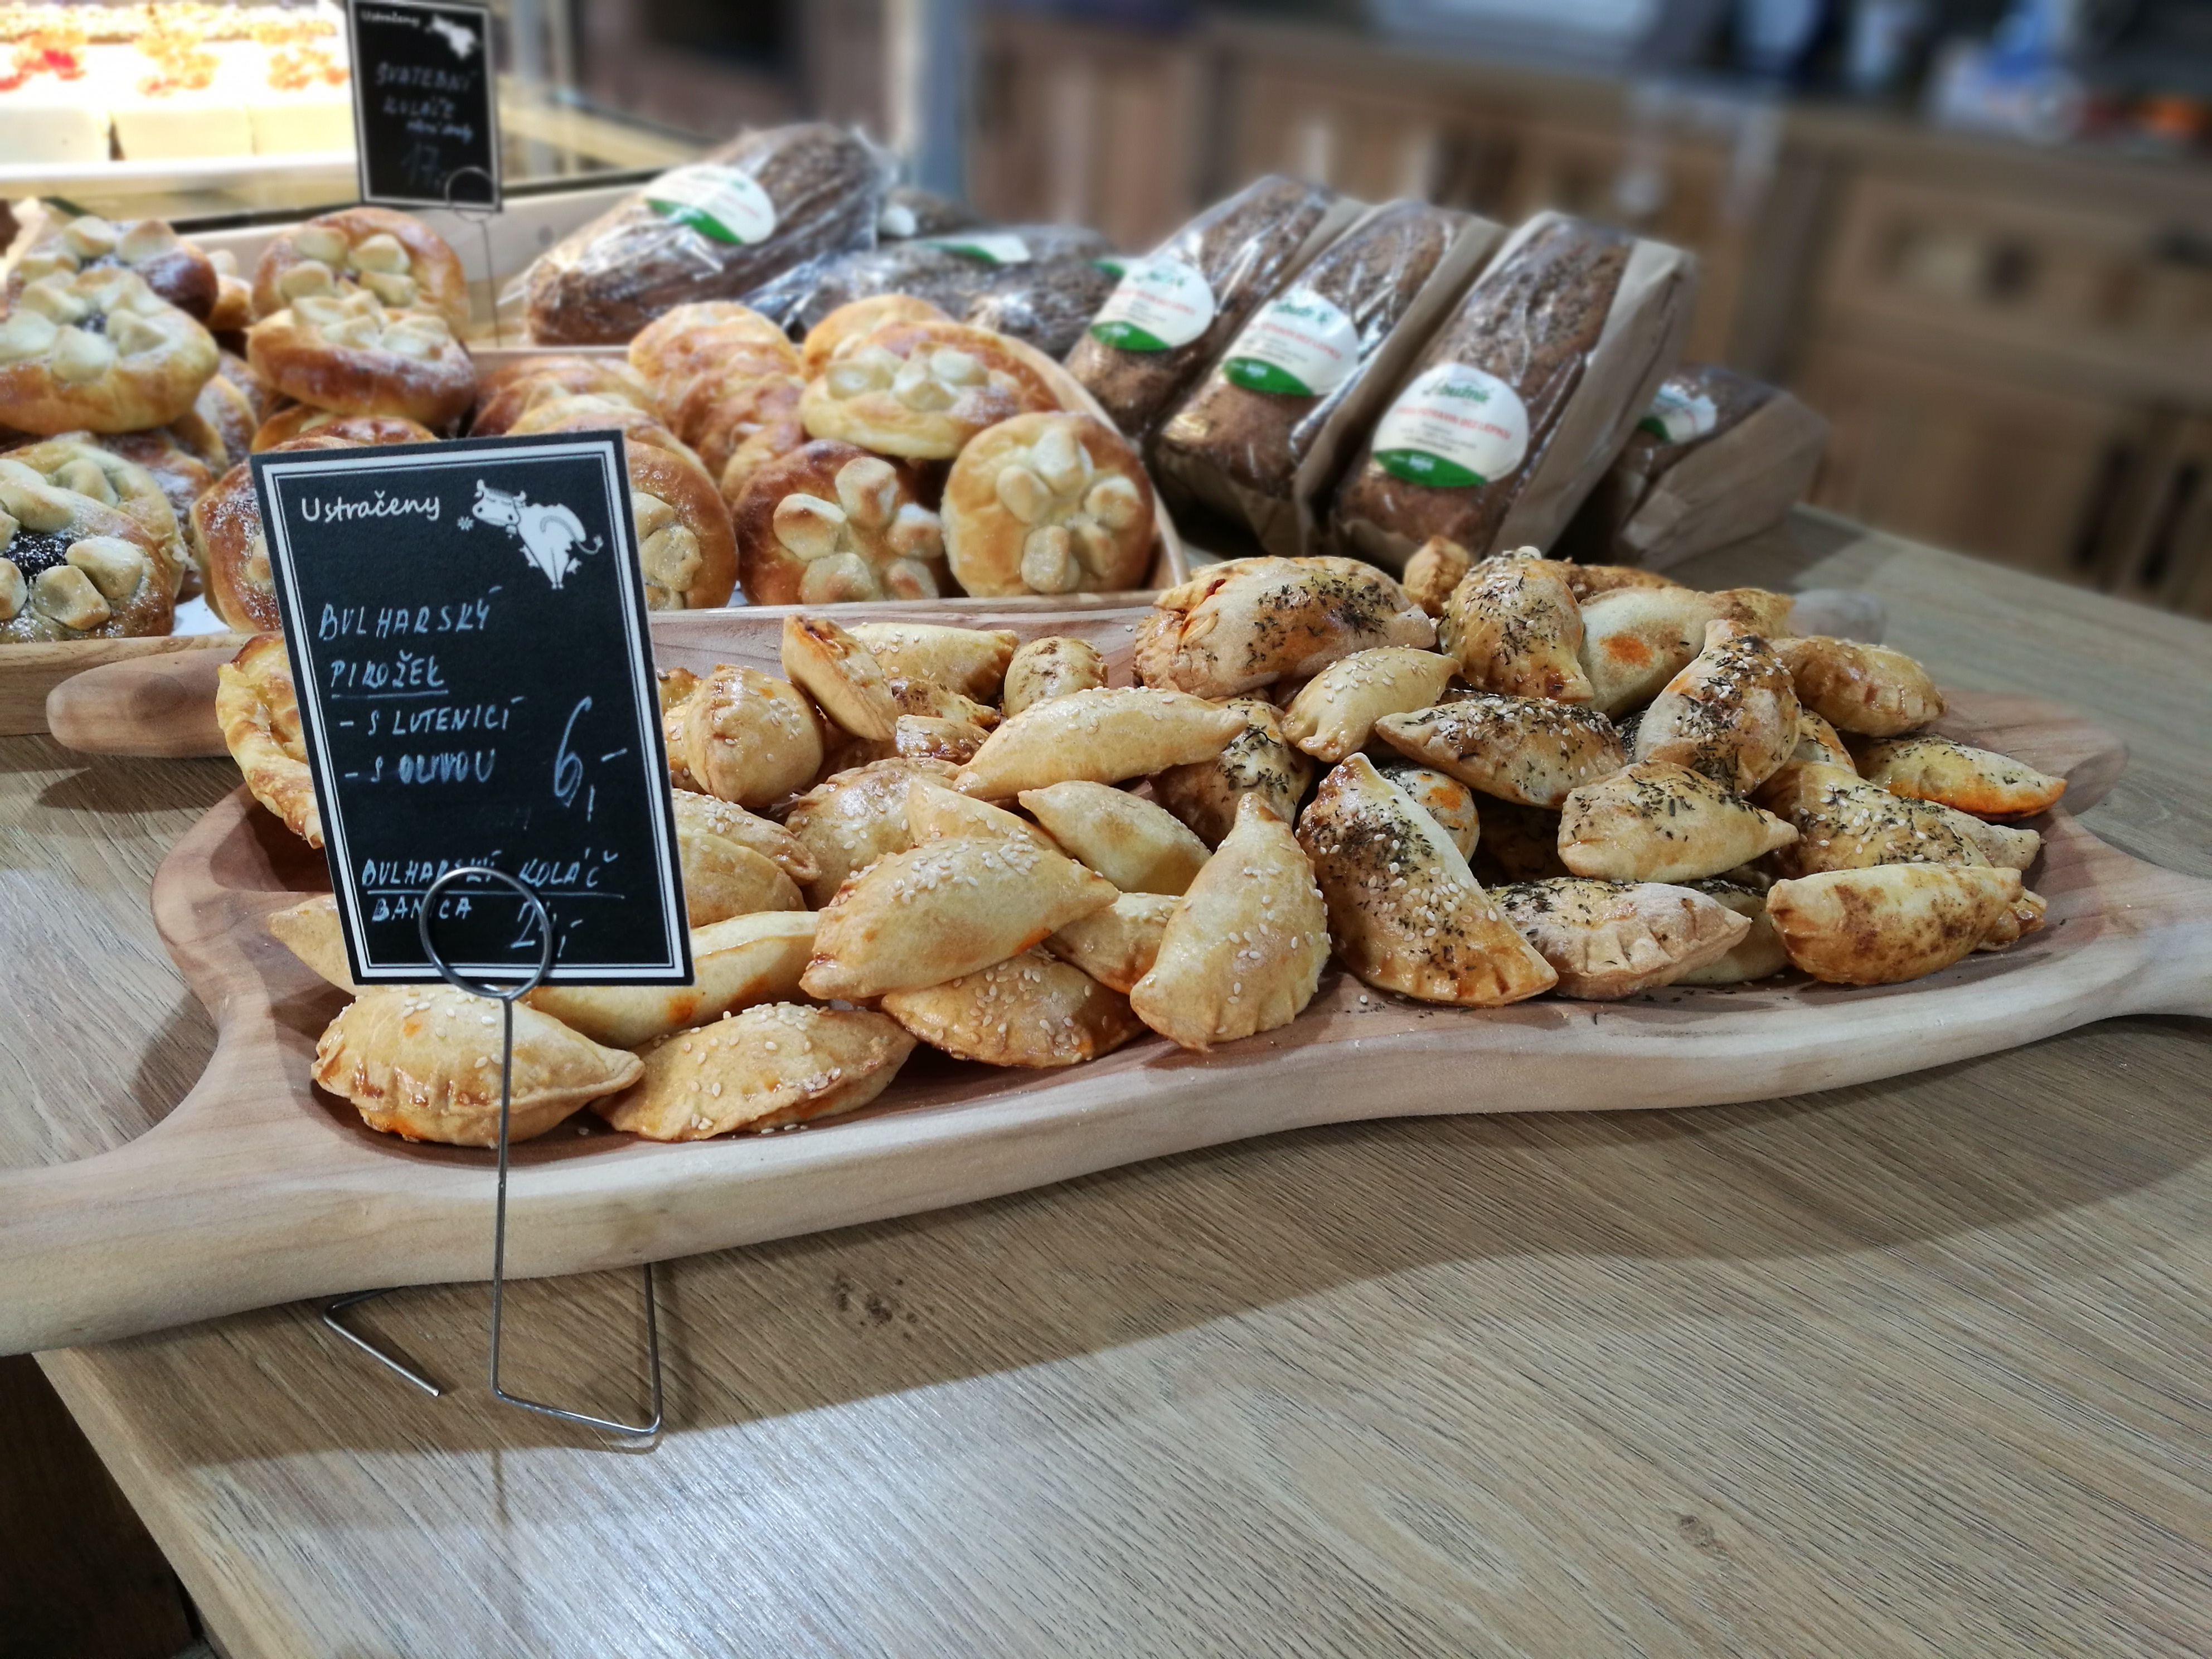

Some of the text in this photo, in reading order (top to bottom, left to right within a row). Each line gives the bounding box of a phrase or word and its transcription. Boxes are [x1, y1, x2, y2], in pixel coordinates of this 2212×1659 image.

[300, 489, 441, 522] Ustračeny
[318, 585, 502, 641] BULHARSKÝ
[331, 649, 445, 690] PIROŽEK
[392, 696, 525, 735] LUTENICÍ
[399, 748, 496, 784] OLIVOU
[519, 847, 619, 888] KOLÁČ
